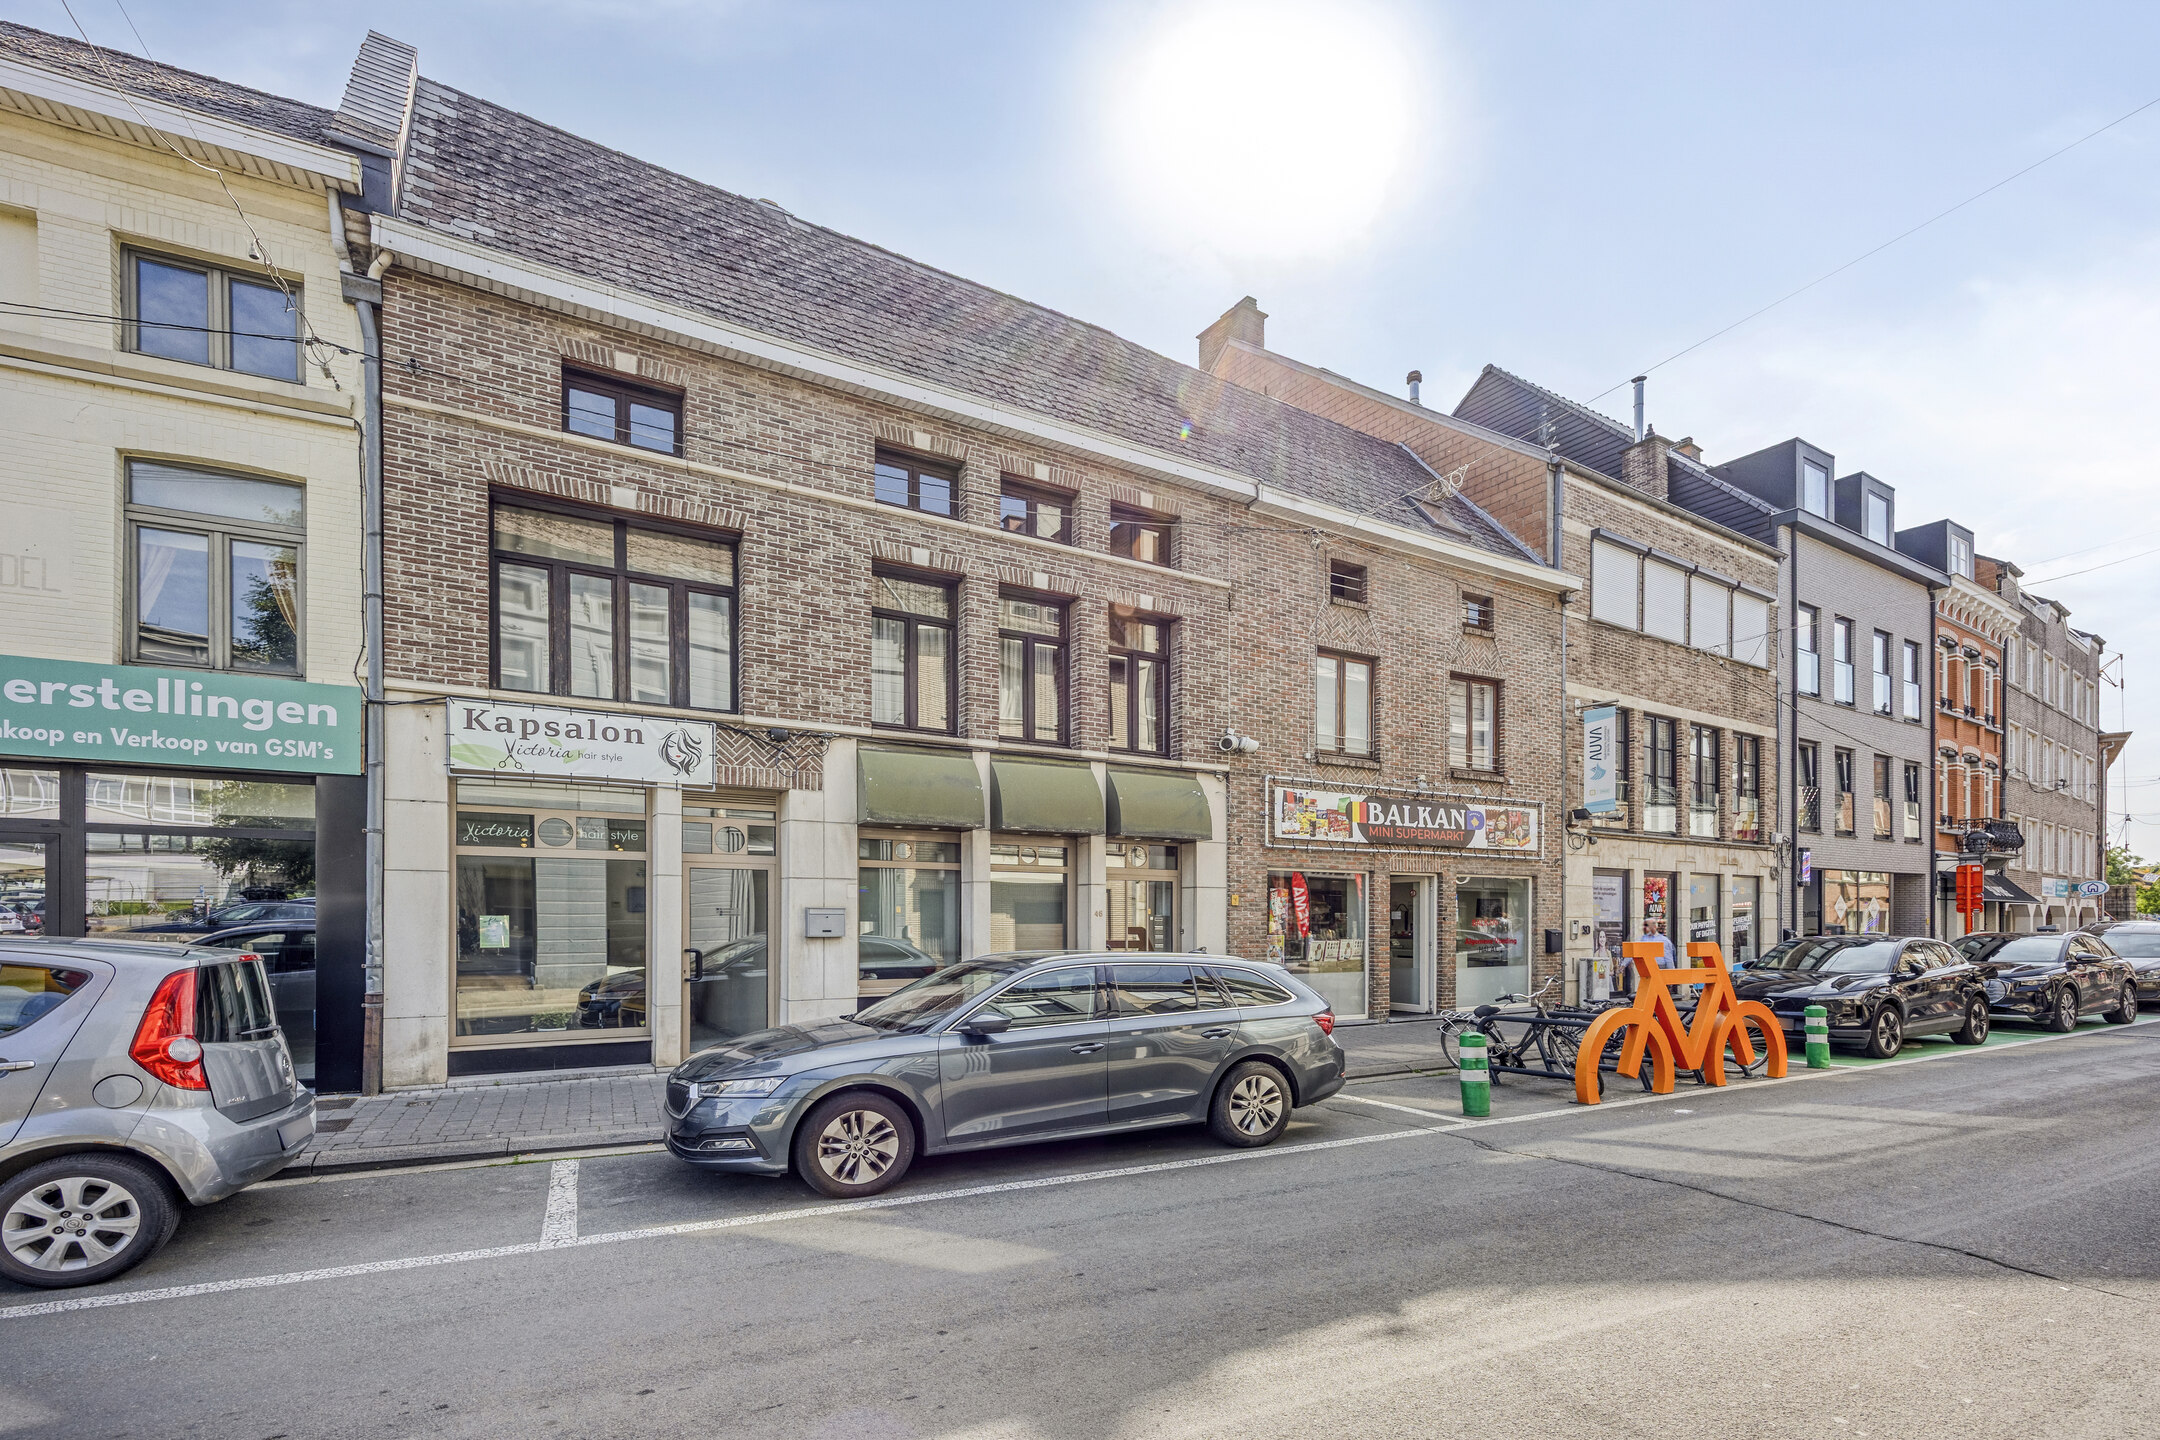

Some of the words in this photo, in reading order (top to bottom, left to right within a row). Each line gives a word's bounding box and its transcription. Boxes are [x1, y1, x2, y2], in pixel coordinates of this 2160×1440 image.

[0, 719, 65, 747] koop
[72, 730, 102, 745] en
[110, 727, 208, 756] Verkoop
[215, 740, 258, 755] van
[265, 738, 334, 760] GSM's
[462, 707, 645, 744] Kapsalon
[500, 738, 573, 766] Victoria
[577, 750, 597, 760] hair
[601, 753, 623, 763] style
[1367, 802, 1466, 830] BALKAN
[463, 823, 532, 840] Victoria
[580, 828, 605, 840] hair
[610, 830, 639, 843] style
[1369, 826, 1394, 838] MINI
[1396, 828, 1465, 841] SUPERMARKT
